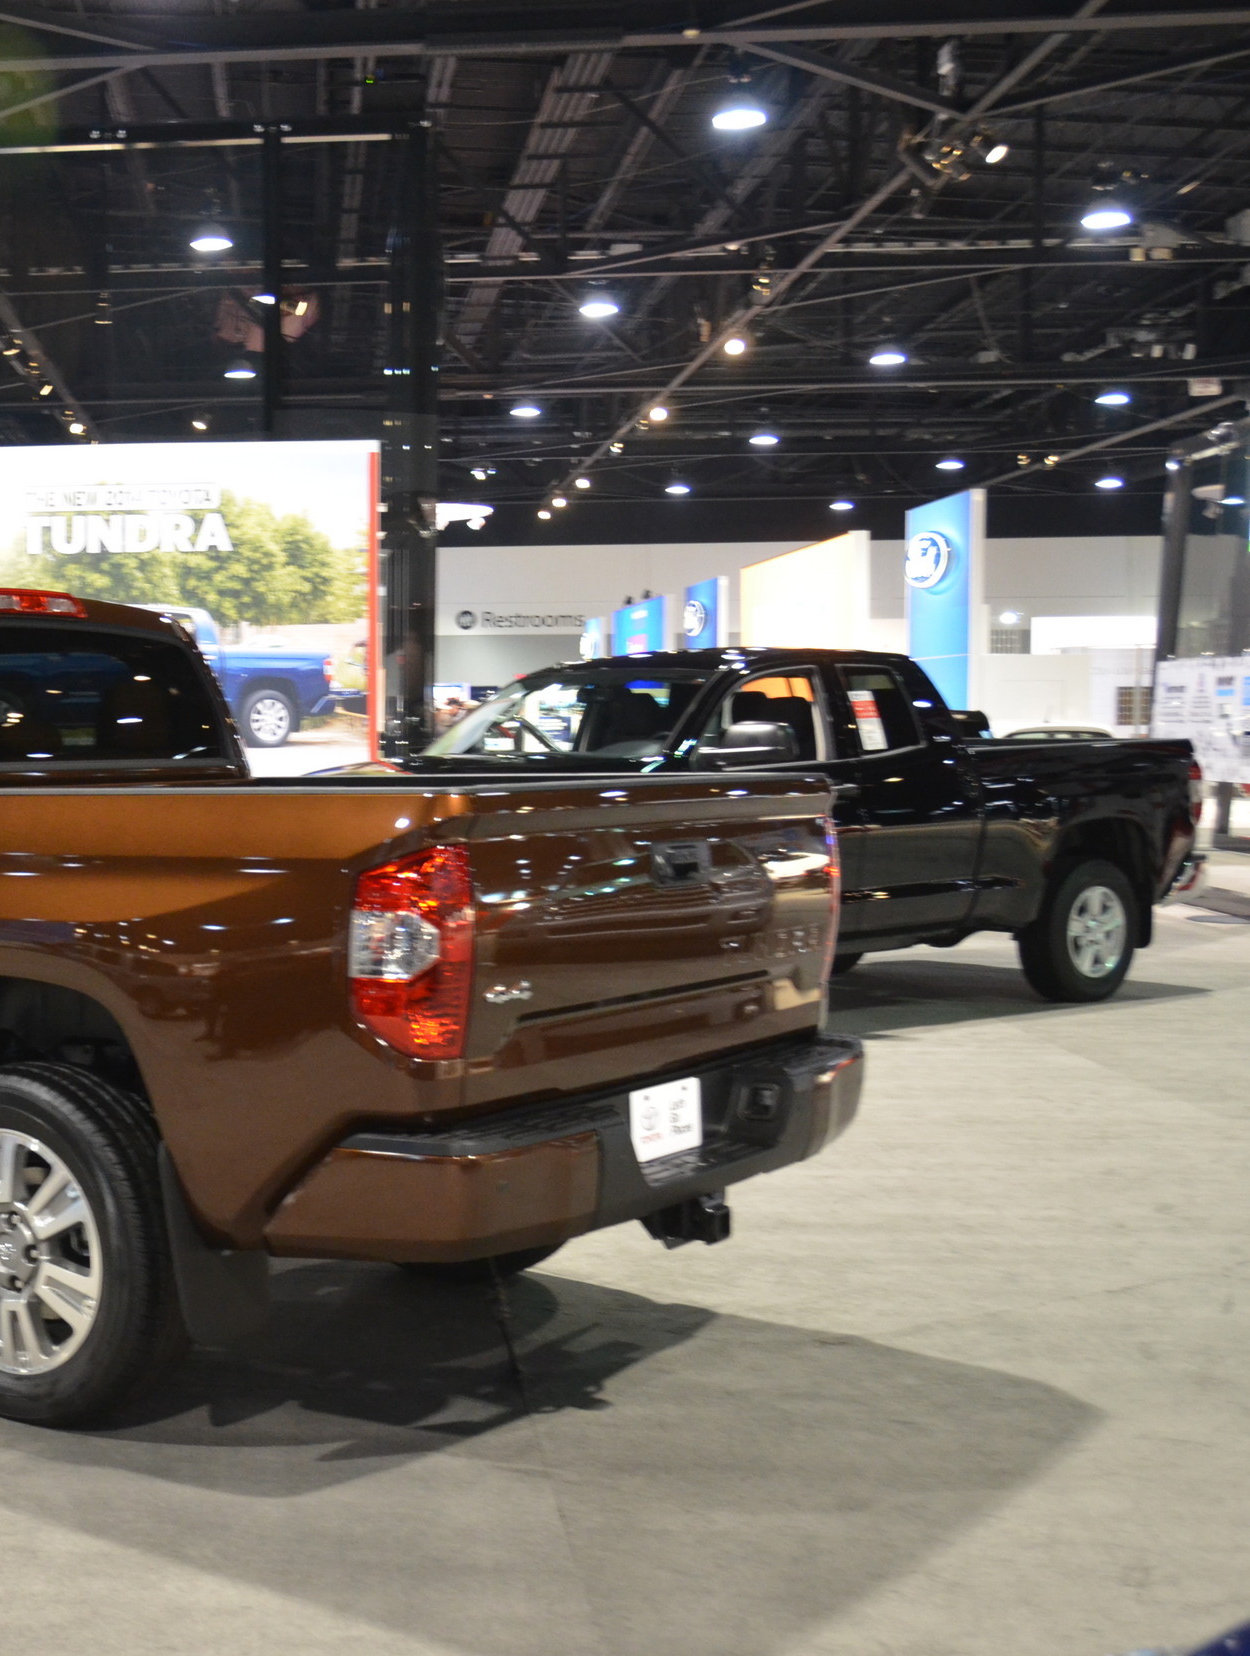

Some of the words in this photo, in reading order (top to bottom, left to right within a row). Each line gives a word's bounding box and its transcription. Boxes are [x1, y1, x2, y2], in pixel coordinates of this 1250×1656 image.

[63, 490, 98, 507] NEW
[147, 488, 213, 506] TOYOTA
[23, 513, 234, 555] TUNDRA
[480, 610, 586, 629] Restrooms
